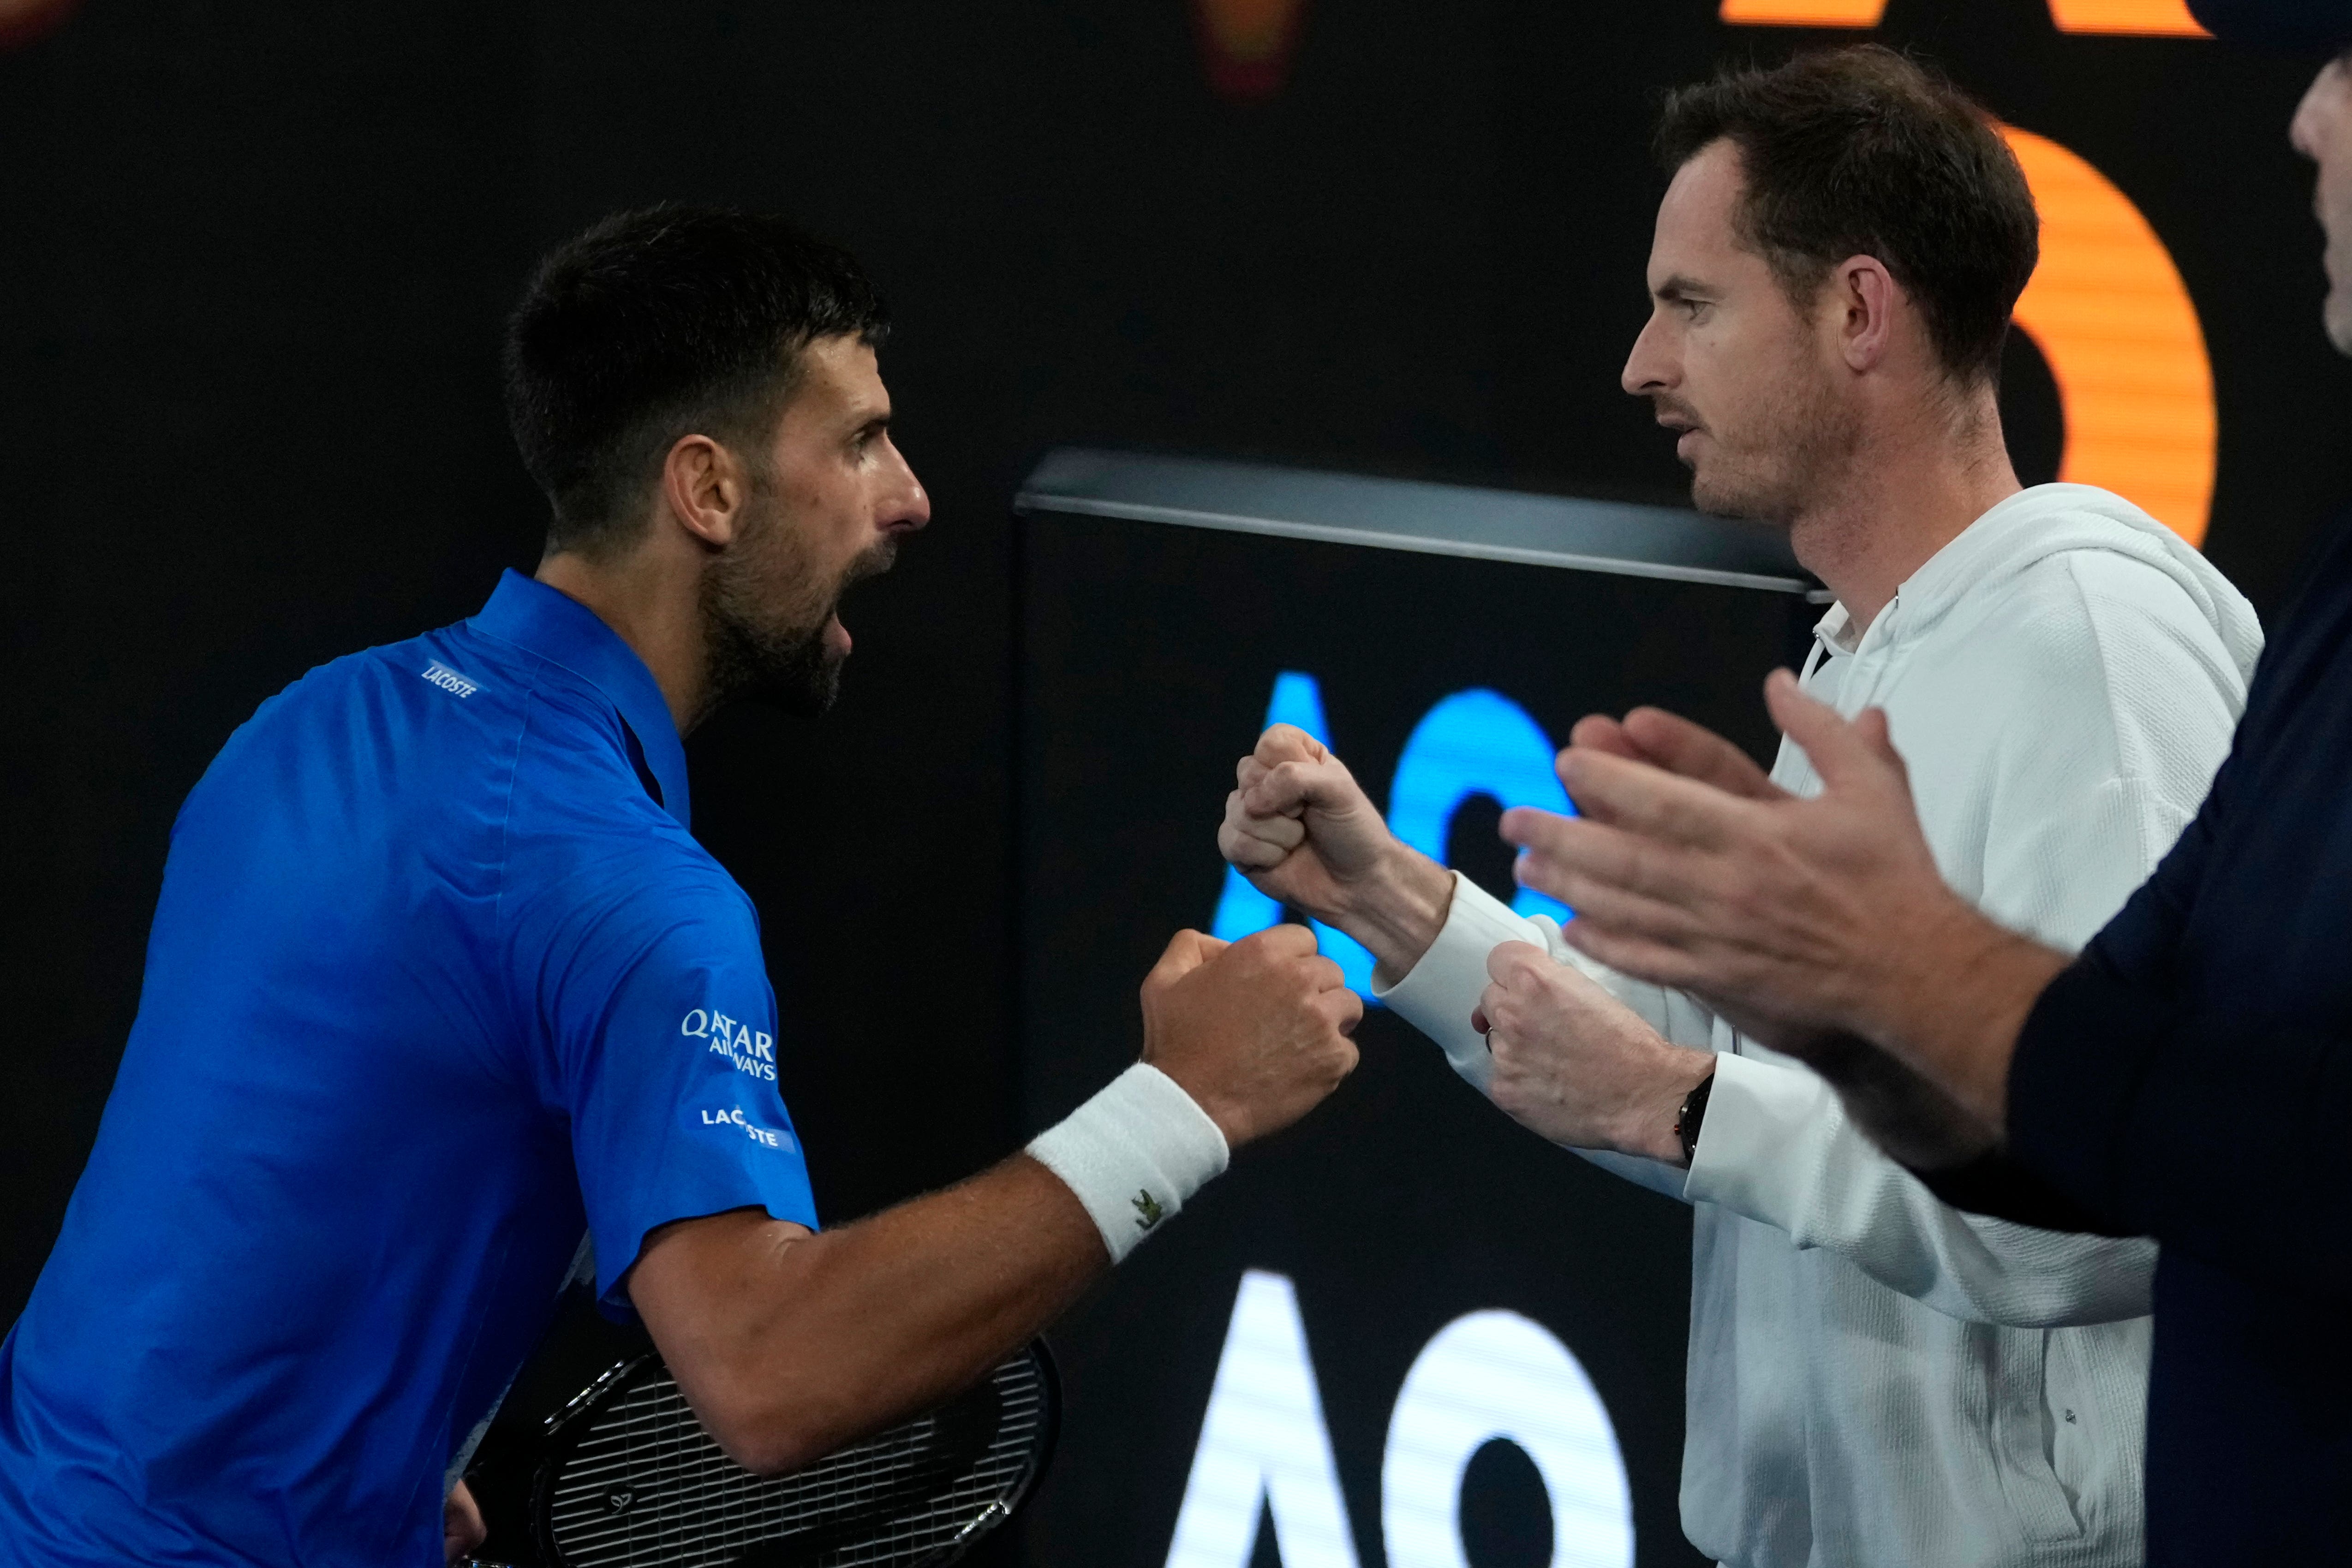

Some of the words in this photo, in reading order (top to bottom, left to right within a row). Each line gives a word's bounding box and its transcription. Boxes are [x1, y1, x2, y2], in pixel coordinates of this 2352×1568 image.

[421, 666, 477, 698] LACOSTE
[681, 1008, 774, 1062] QATAR
[701, 1109, 779, 1147] LACSTE
[1163, 1269, 1637, 1568] AO
